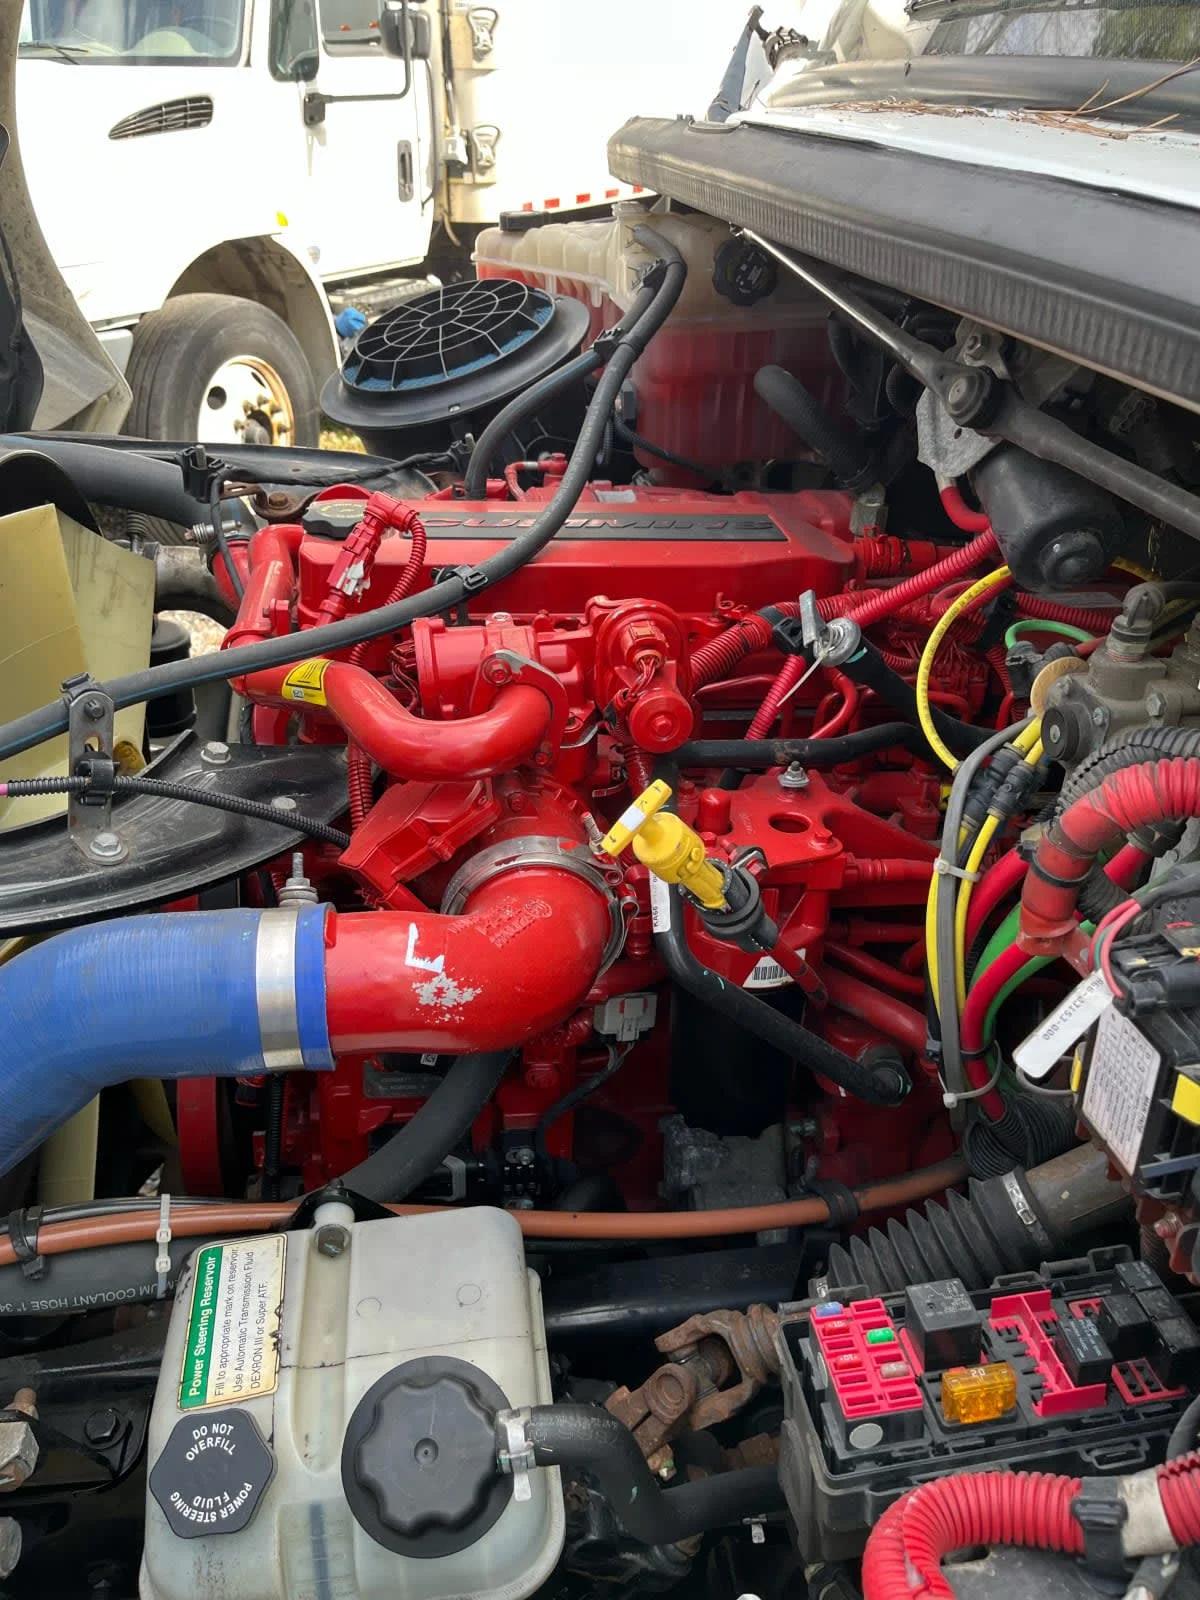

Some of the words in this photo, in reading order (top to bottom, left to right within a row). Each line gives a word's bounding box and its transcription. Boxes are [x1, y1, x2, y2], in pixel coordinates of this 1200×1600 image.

[243, 1251, 254, 1270] Fluid
[200, 1256, 216, 1307] Reservoir
[226, 1283, 235, 1294] on
[32, 1299, 69, 1311] HOSE
[72, 1288, 136, 1306] COOLANT
[224, 1297, 233, 1317] mark
[239, 1272, 253, 1328] Transmission
[256, 1301, 267, 1324] Super
[194, 1309, 211, 1356] Steering
[257, 1326, 264, 1336] or
[219, 1319, 232, 1369] appropriate
[236, 1328, 248, 1371] Automatic
[255, 1337, 263, 1346] III
[188, 1358, 205, 1396] Power
[219, 1370, 226, 1380] to
[250, 1347, 263, 1389] DEXRON
[970, 1368, 986, 1377] 20
[214, 1380, 224, 1396] Fill
[233, 1373, 244, 1393] Use
[192, 1425, 208, 1440] DO
[212, 1423, 234, 1436] NOT
[185, 1436, 236, 1461] OVERFILL
[170, 1491, 217, 1523] STEERING
[193, 1491, 230, 1509] FLUID
[219, 1482, 253, 1519] POWER
